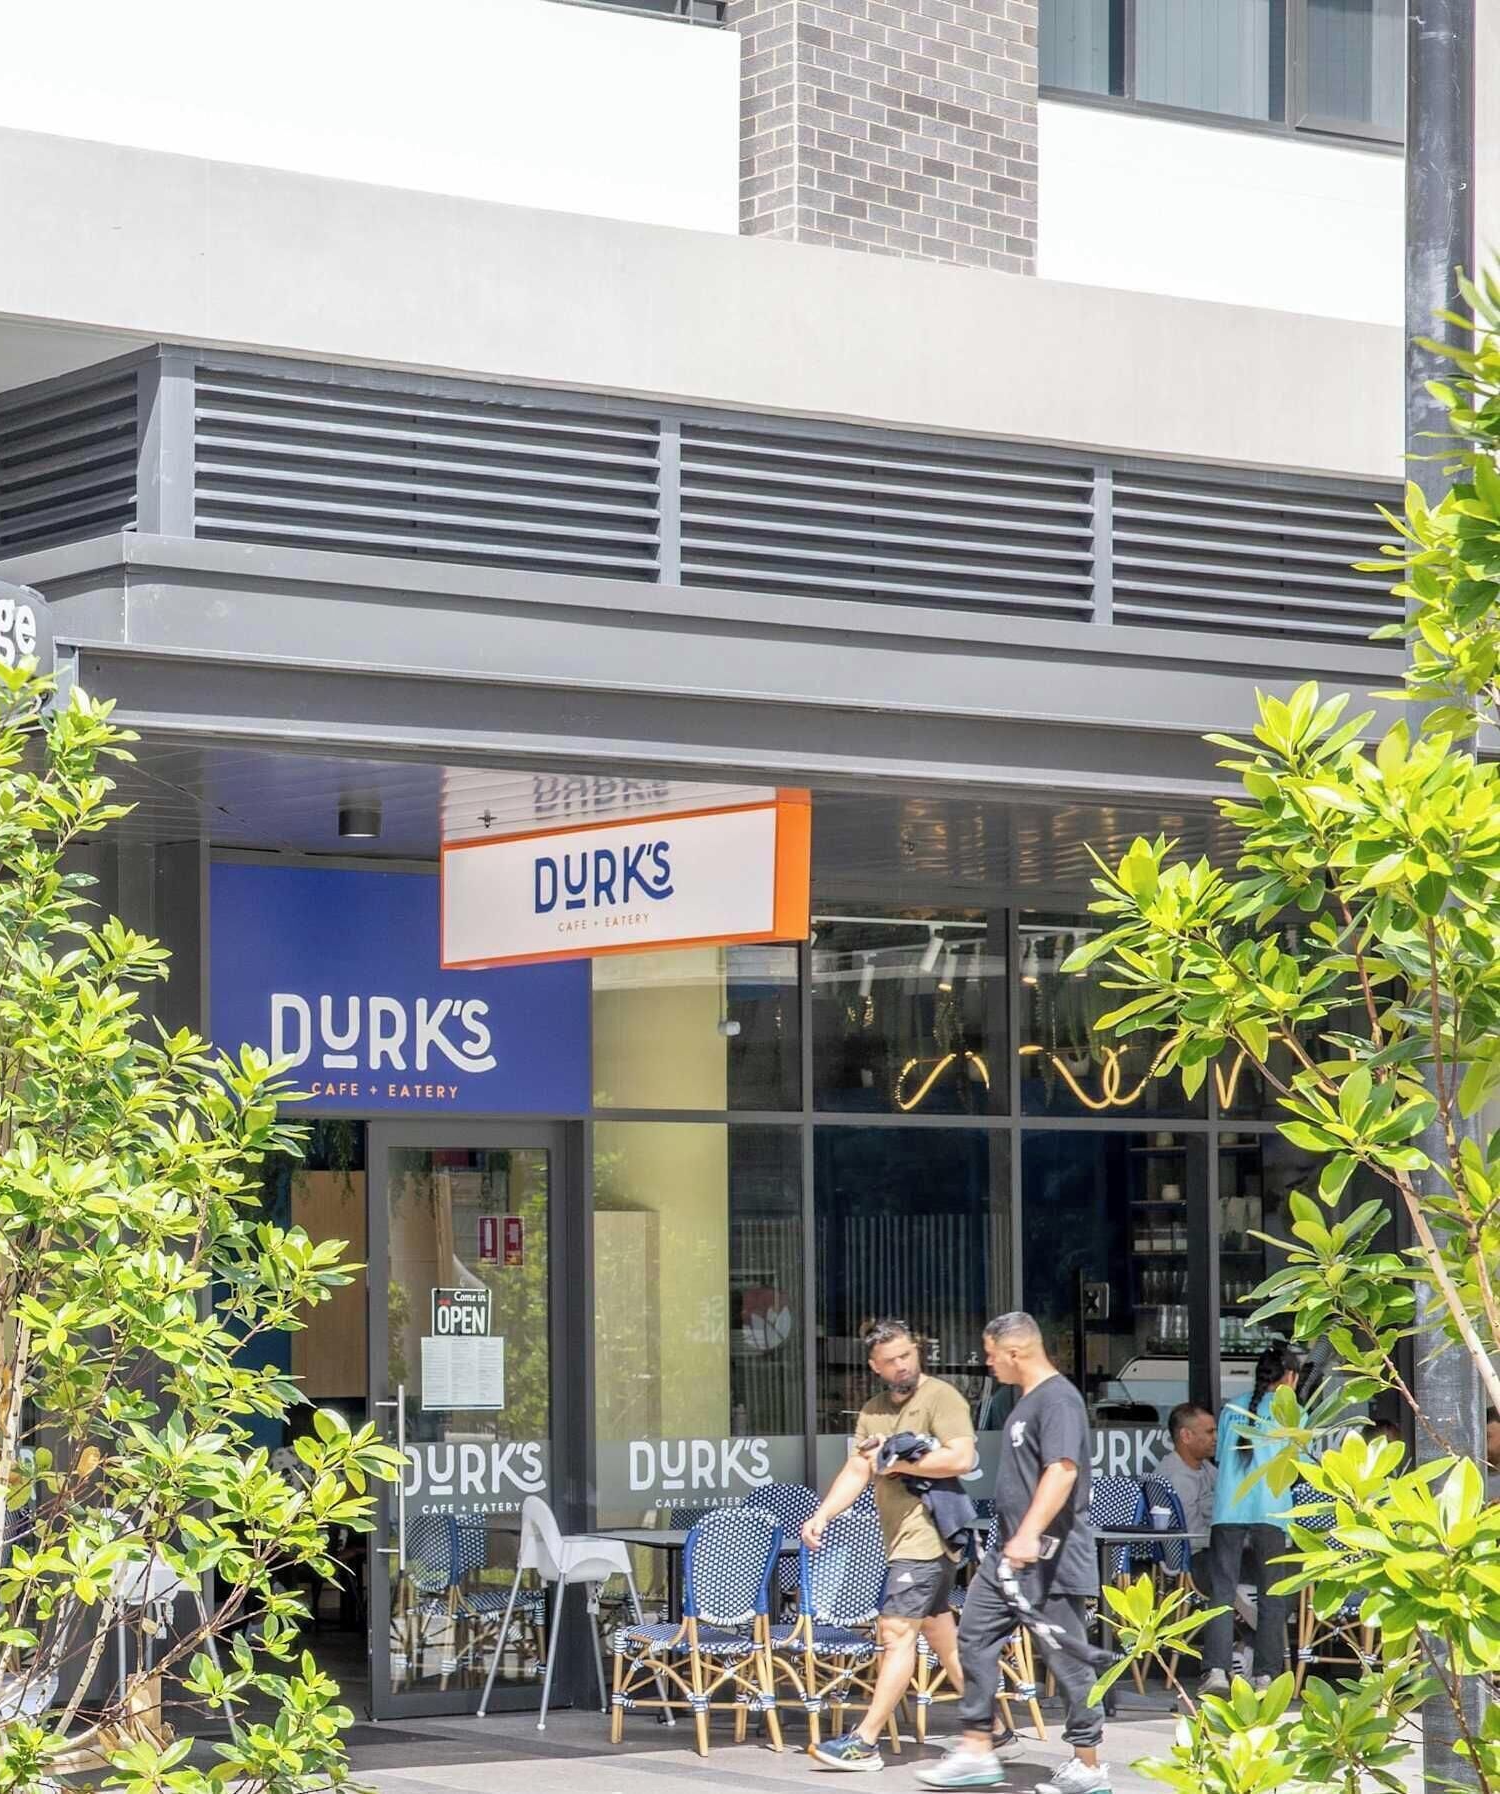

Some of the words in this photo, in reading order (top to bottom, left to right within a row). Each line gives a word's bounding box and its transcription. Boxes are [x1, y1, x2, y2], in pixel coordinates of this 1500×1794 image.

[534, 840, 675, 914] DURK'S
[557, 919, 588, 932] CAFE
[604, 912, 651, 928] EATERY
[270, 992, 498, 1074] DURK'S
[311, 1081, 359, 1097] CAFE
[388, 1083, 459, 1098] EATERY
[453, 1291, 477, 1302] Come
[477, 1292, 487, 1302] in
[437, 1305, 486, 1335] OPEN
[628, 1438, 774, 1491] DURK'S
[421, 1504, 454, 1515] CAFE
[473, 1502, 522, 1513] EATERY
[655, 1498, 686, 1508] CAFE
